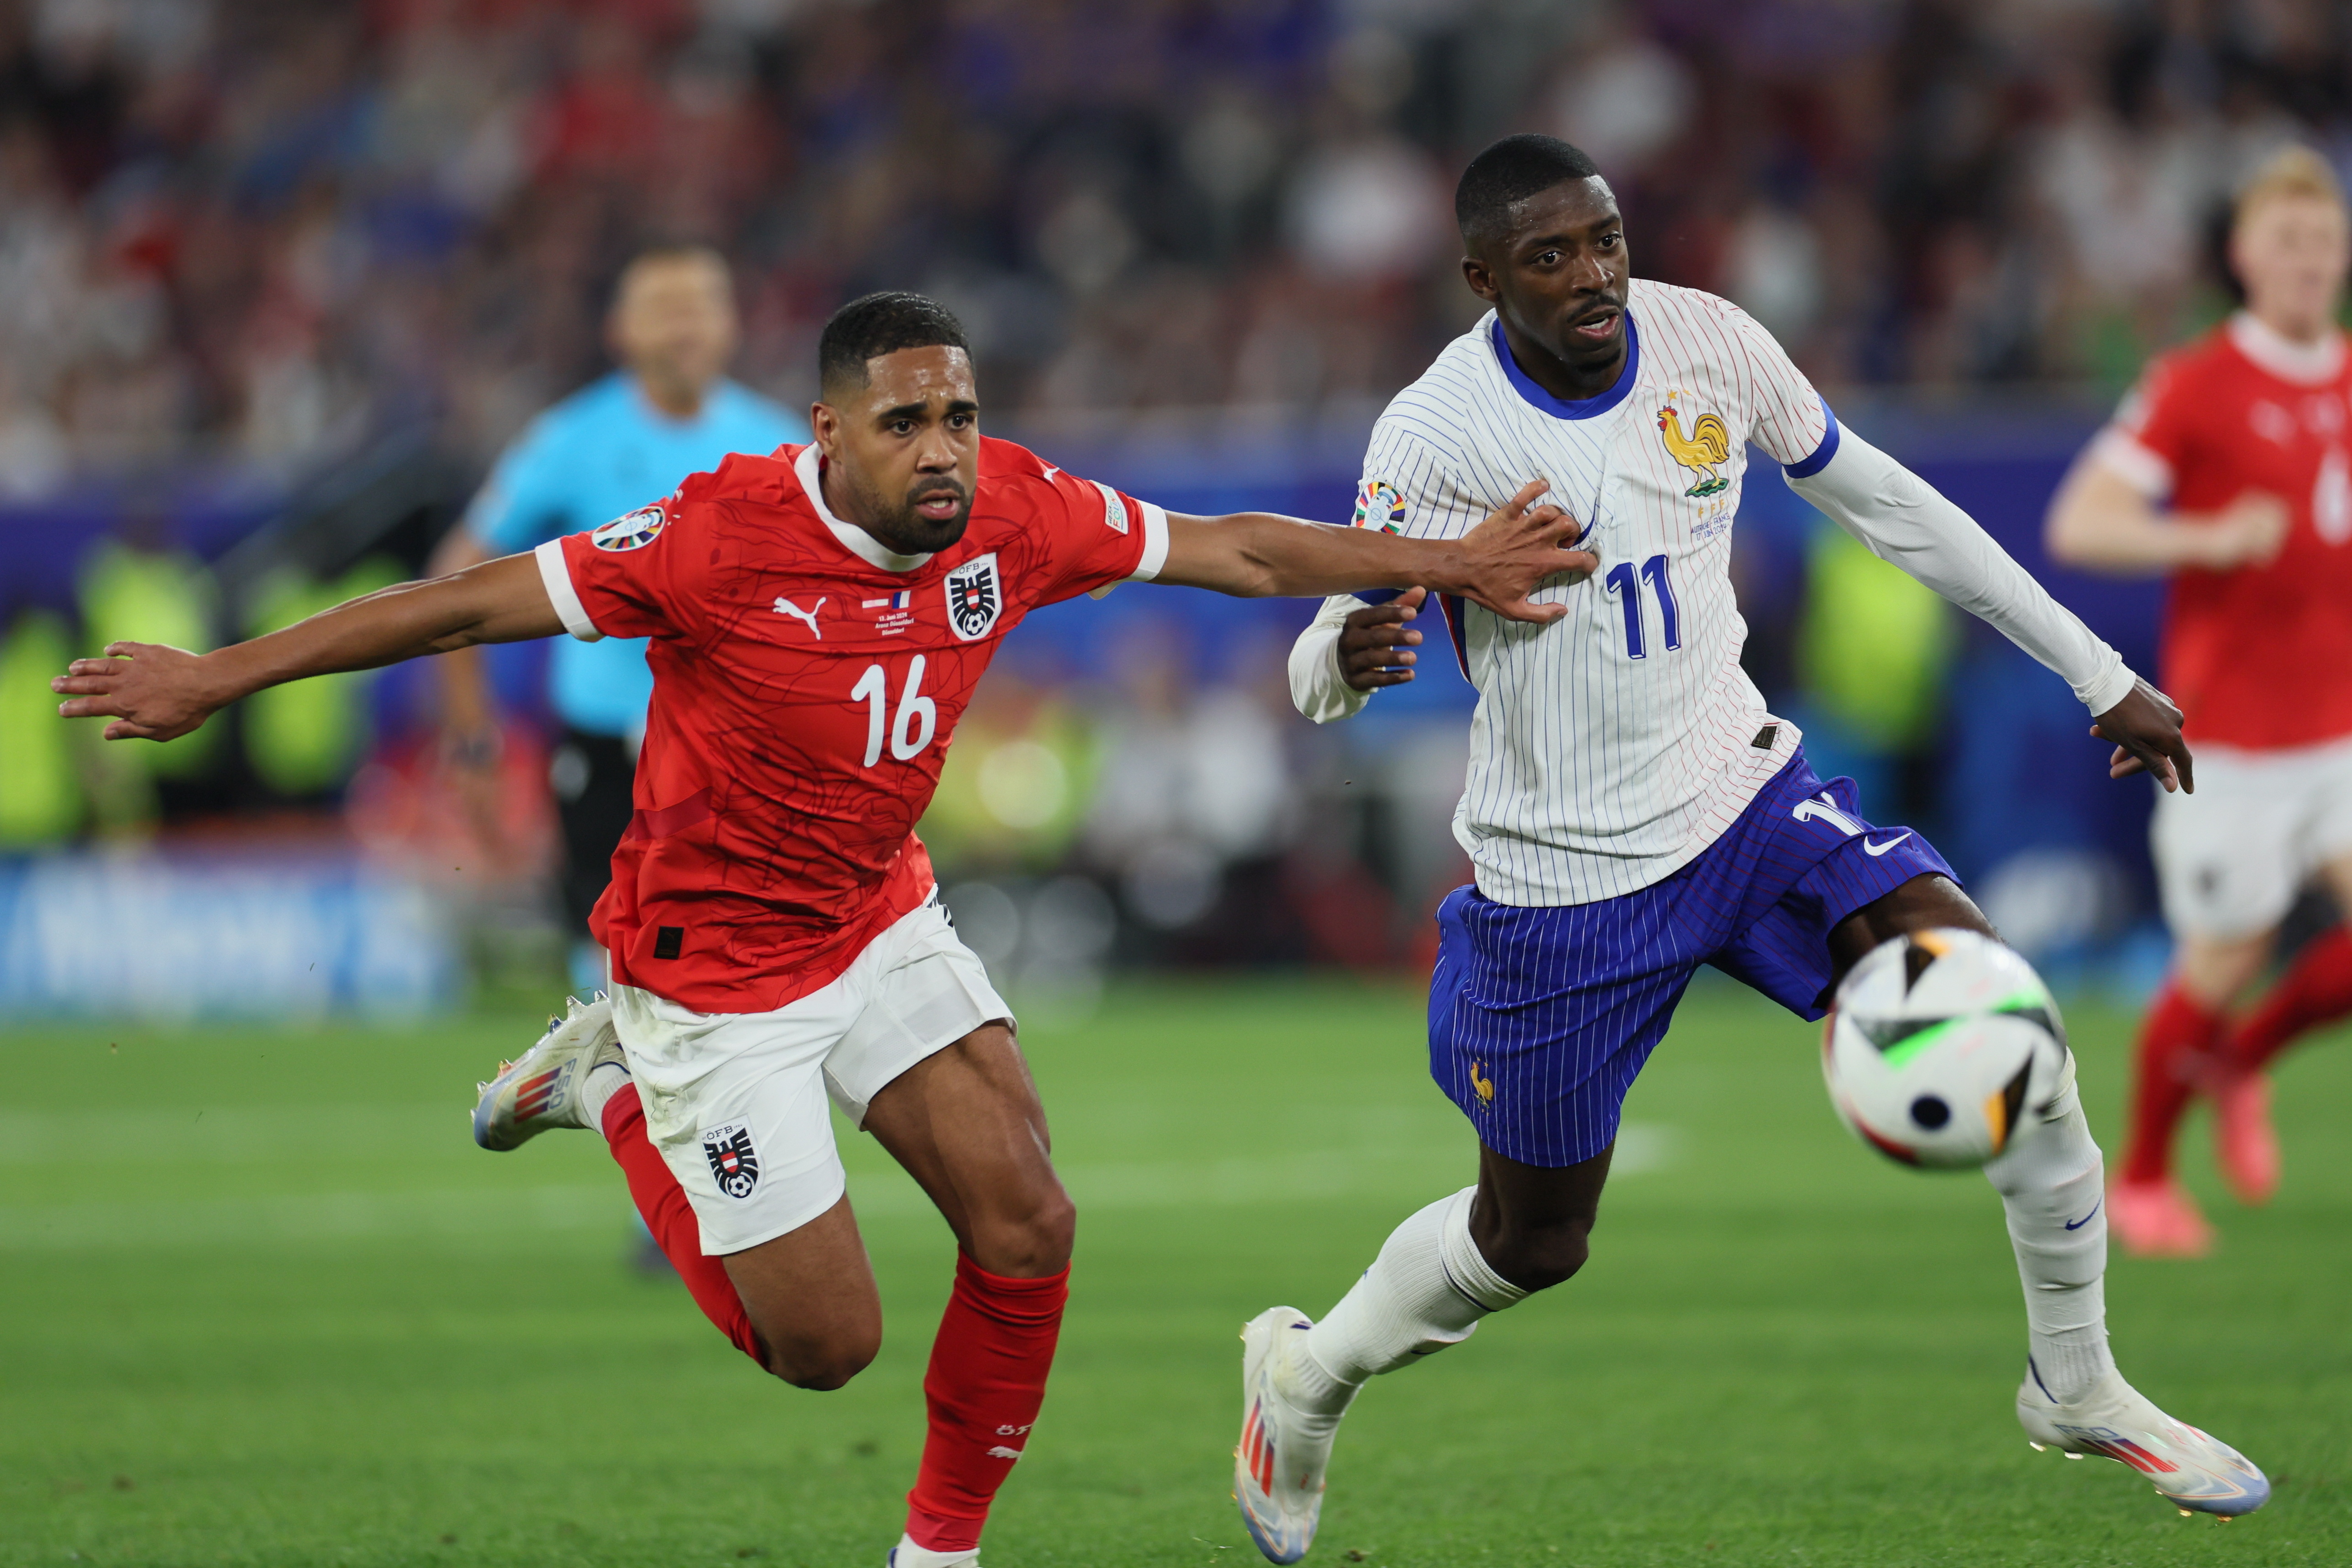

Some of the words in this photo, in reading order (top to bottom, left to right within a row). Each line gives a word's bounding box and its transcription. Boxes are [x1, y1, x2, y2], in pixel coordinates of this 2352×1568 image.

[1713, 512, 1730, 525] FRANCE
[1606, 554, 1681, 660] 11
[850, 654, 936, 768] 16
[707, 1126, 733, 1140] ÖFB
